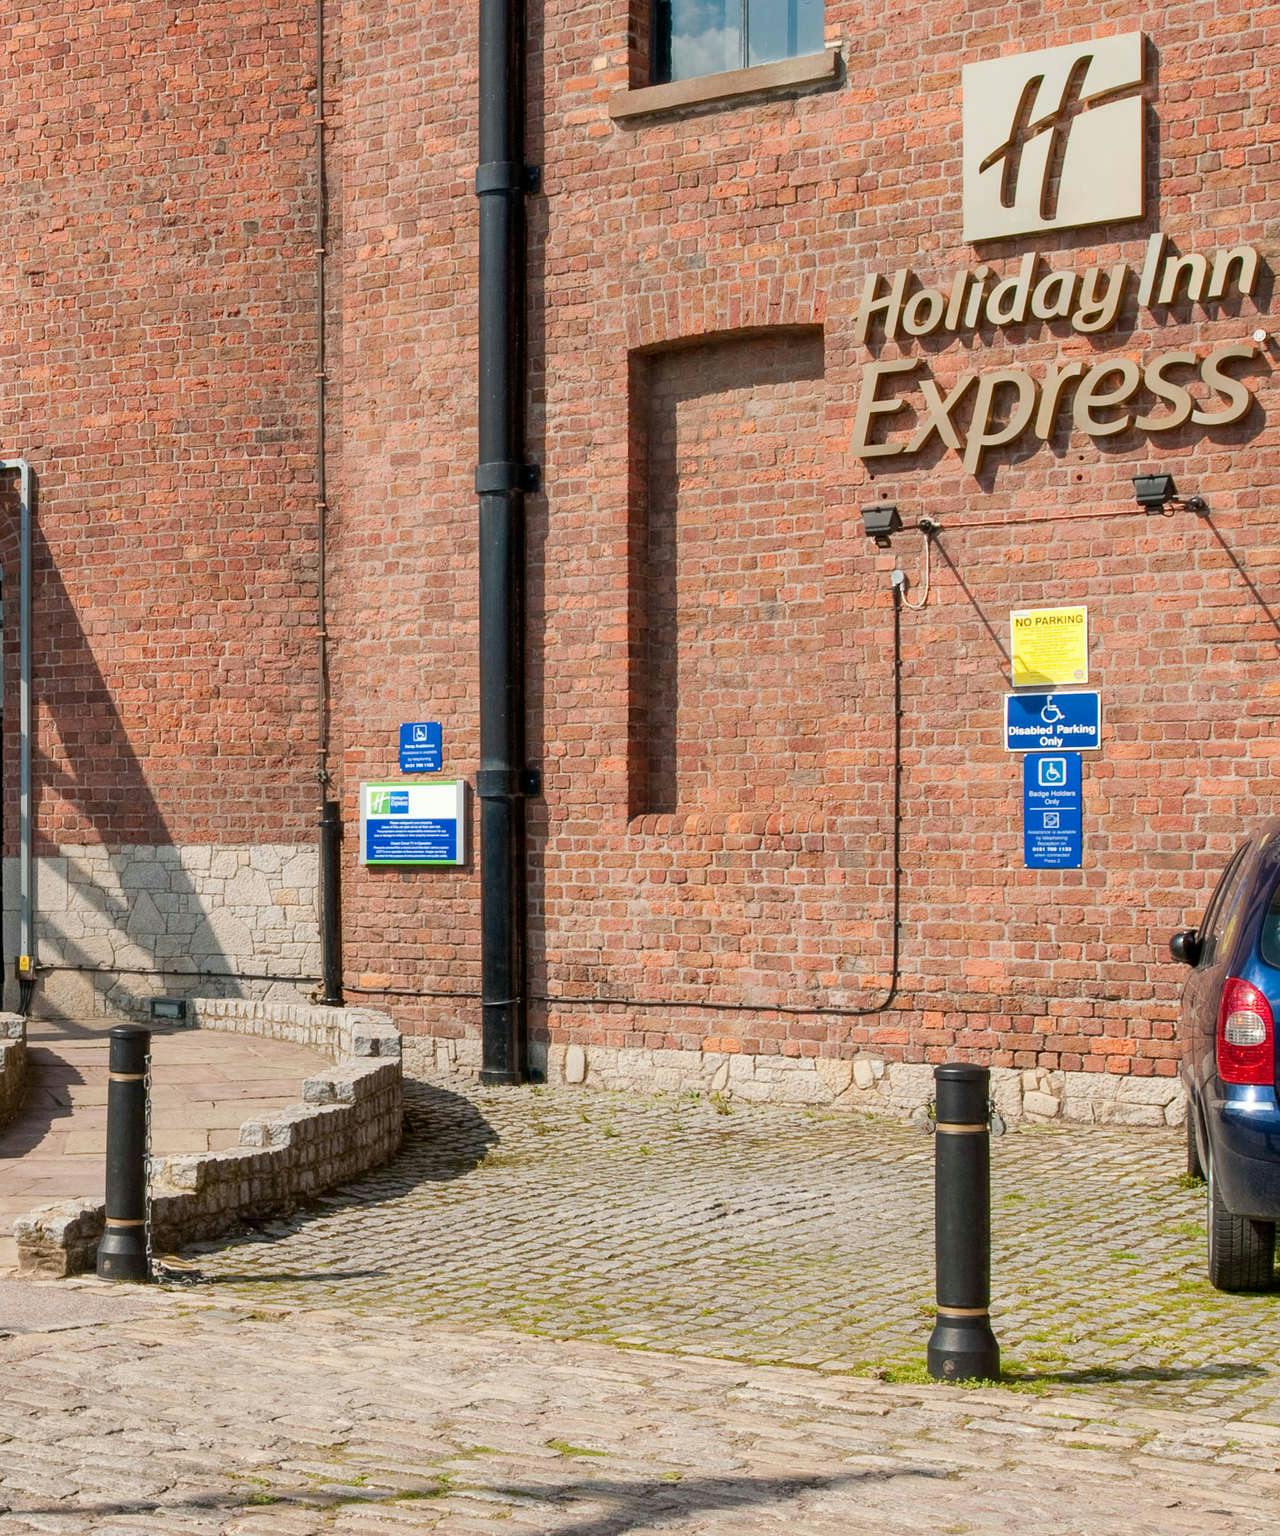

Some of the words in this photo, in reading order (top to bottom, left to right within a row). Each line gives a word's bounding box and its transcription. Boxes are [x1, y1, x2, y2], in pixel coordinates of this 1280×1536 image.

[854, 252, 1133, 345] Holiday
[1137, 232, 1263, 307] Inn
[849, 344, 1261, 476] Express
[1015, 618, 1032, 627] NO
[1035, 614, 1084, 626] PARKING
[1008, 725, 1053, 736] Disabled
[1056, 724, 1096, 735] Parking
[1039, 736, 1063, 747] Only
[1028, 790, 1050, 799] Badge
[1050, 790, 1076, 798] Holders
[1043, 798, 1060, 806] Only
